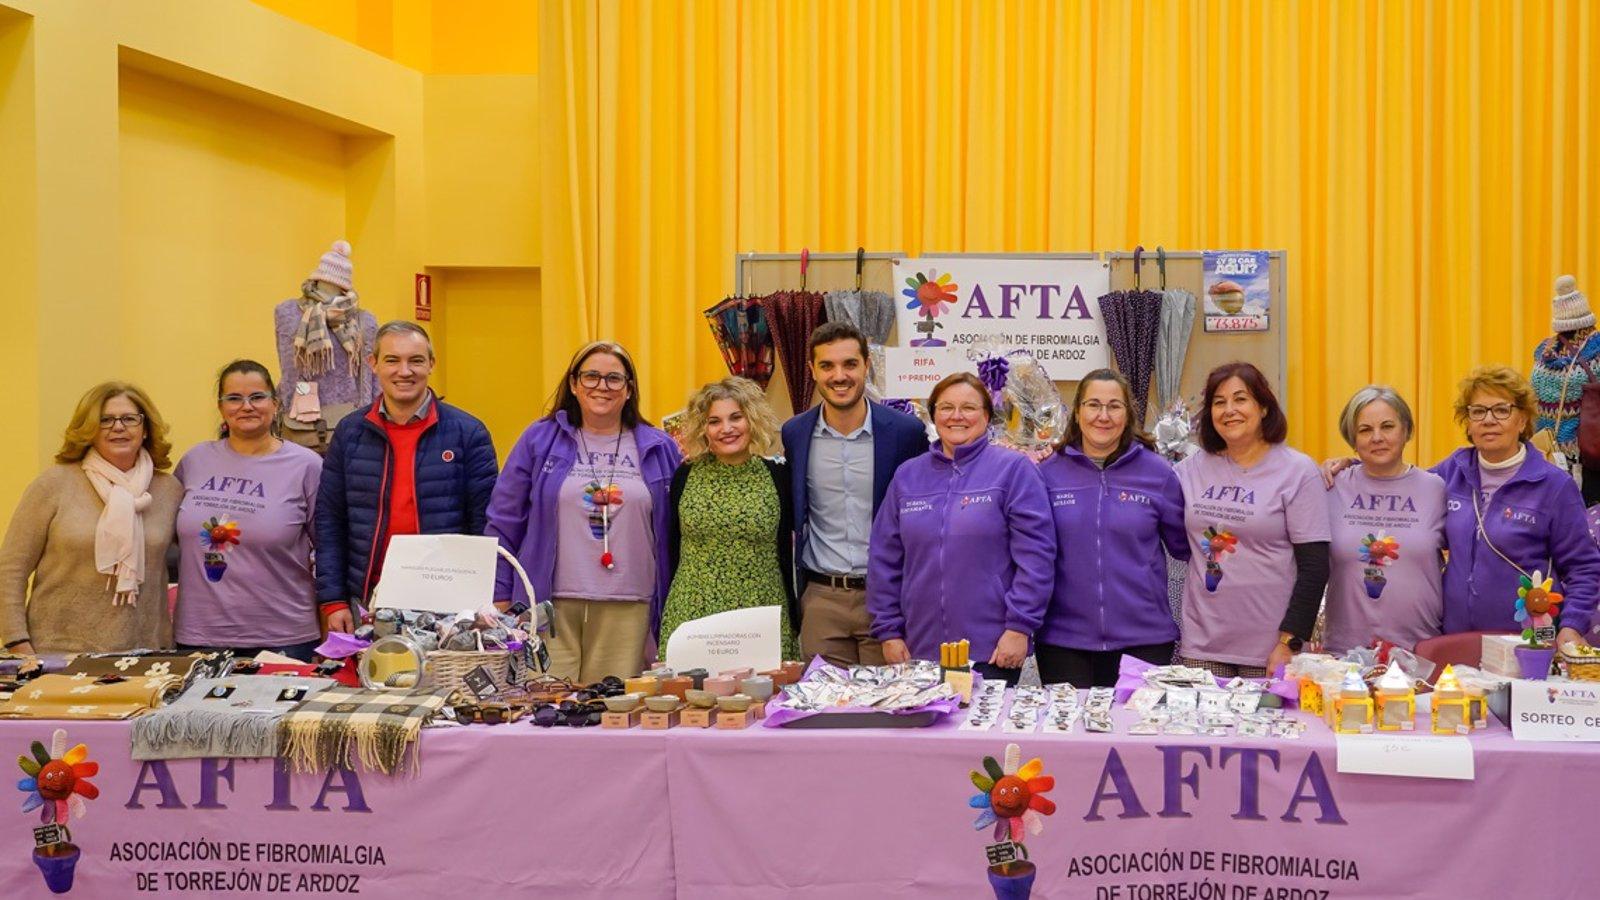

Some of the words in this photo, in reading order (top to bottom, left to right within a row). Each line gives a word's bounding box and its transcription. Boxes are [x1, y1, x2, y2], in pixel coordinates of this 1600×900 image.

[961, 283, 1094, 320] AFTA
[1015, 334, 1028, 344] DE
[1030, 334, 1100, 345] FIBROMIALGIA
[912, 358, 936, 367] RIFA
[1036, 349, 1049, 360] DE
[1052, 350, 1086, 360] ARDOZ
[908, 374, 942, 382] PREMIO
[201, 475, 265, 498] AFTA
[1201, 485, 1255, 505] AFTA
[970, 495, 992, 504] AFTA
[1128, 494, 1151, 505] AFTA
[1350, 493, 1417, 513] AFTA
[1561, 689, 1596, 699] AFTA
[1520, 712, 1576, 726] SORTEO
[1082, 745, 1349, 826] AFTA
[109, 837, 222, 862] ASOCIACIÓN
[227, 842, 250, 862] DE
[256, 843, 386, 866] FIBROMIALGIA
[1067, 848, 1184, 878] ASOCIACIÓN
[1189, 850, 1216, 872] DE
[1221, 852, 1360, 881] FIBROMIALGIA
[136, 873, 158, 892] DE
[164, 868, 262, 893] TORREJÓN
[267, 873, 291, 893] DE
[295, 873, 361, 894] ARDOZ
[1096, 886, 1121, 900] DE
[1126, 877, 1227, 900] TORREJÓN
[1232, 885, 1257, 900] DE
[1262, 888, 1330, 900] ARDOZ
